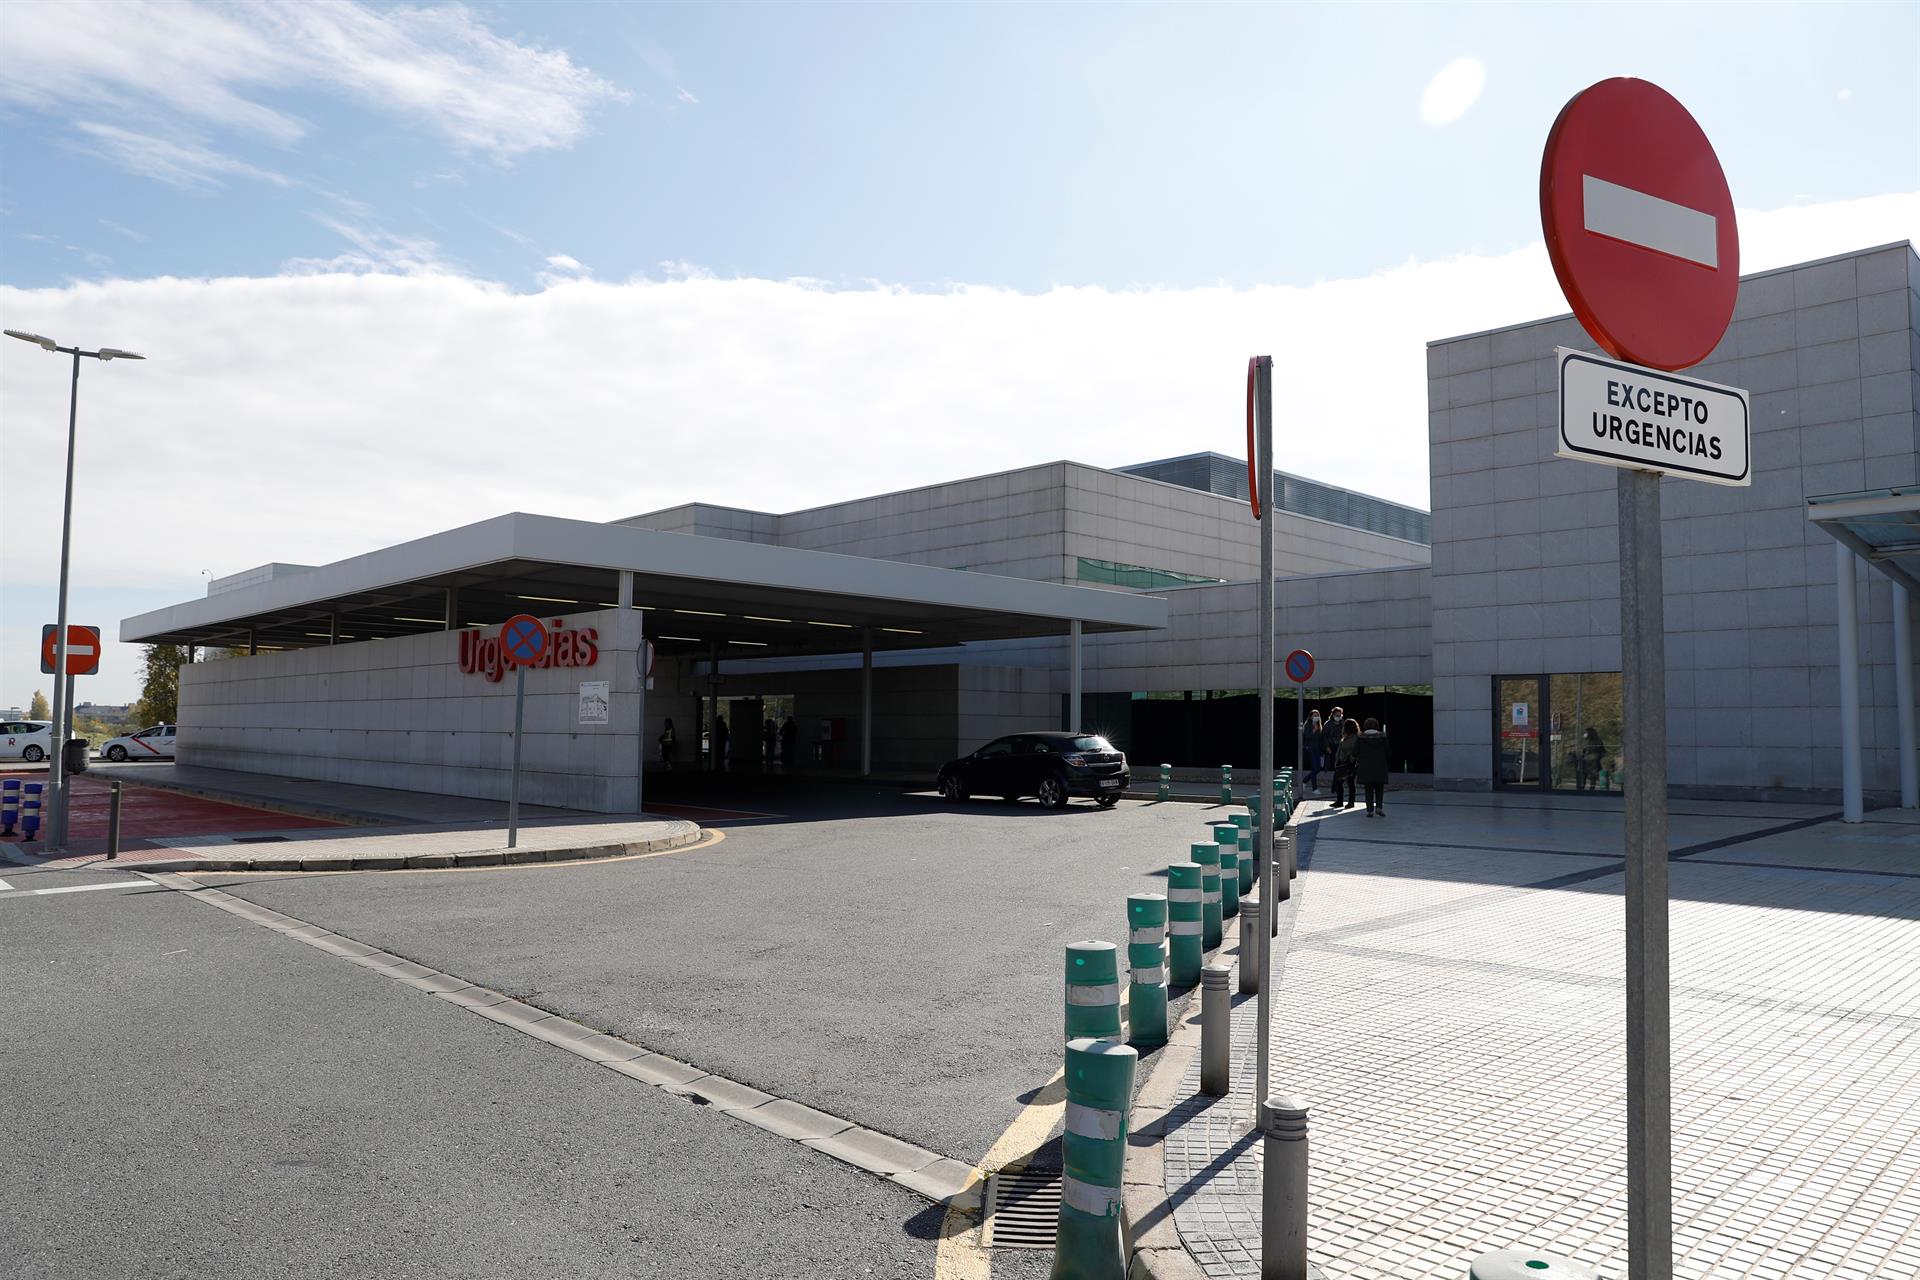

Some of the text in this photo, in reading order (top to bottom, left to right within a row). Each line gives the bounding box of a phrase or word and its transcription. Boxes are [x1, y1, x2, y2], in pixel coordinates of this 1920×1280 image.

[1607, 380, 1709, 425] EXCEPTO
[1592, 411, 1722, 460] URGENCIAS
[459, 619, 598, 683] Urgias
